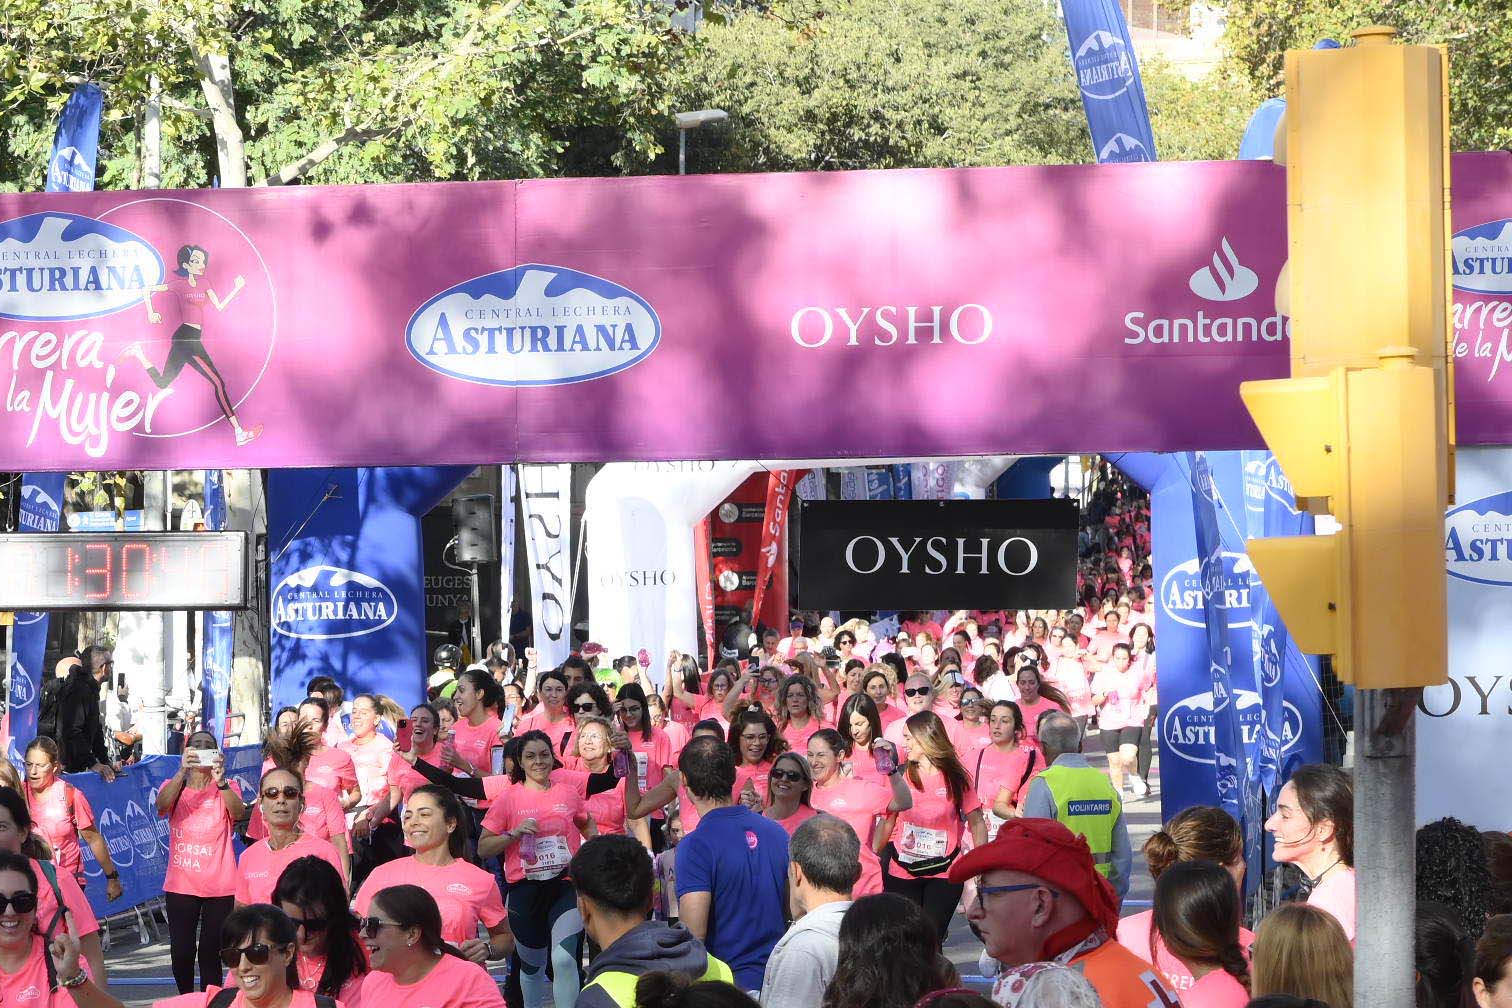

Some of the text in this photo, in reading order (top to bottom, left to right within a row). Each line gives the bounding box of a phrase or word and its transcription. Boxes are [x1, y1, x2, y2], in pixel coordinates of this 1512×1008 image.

[465, 304, 633, 320] CENTRAL LECHERA
[790, 303, 993, 348] OYSHO
[425, 312, 642, 356] ASTURIANA
[1475, 330, 1493, 358] la
[6, 374, 32, 413] la
[26, 363, 175, 458] Mujer
[845, 535, 1039, 577] OYSHO
[600, 569, 677, 587] OYSHO
[275, 594, 388, 624] ASTURIANA
[1417, 674, 1512, 718] OY
